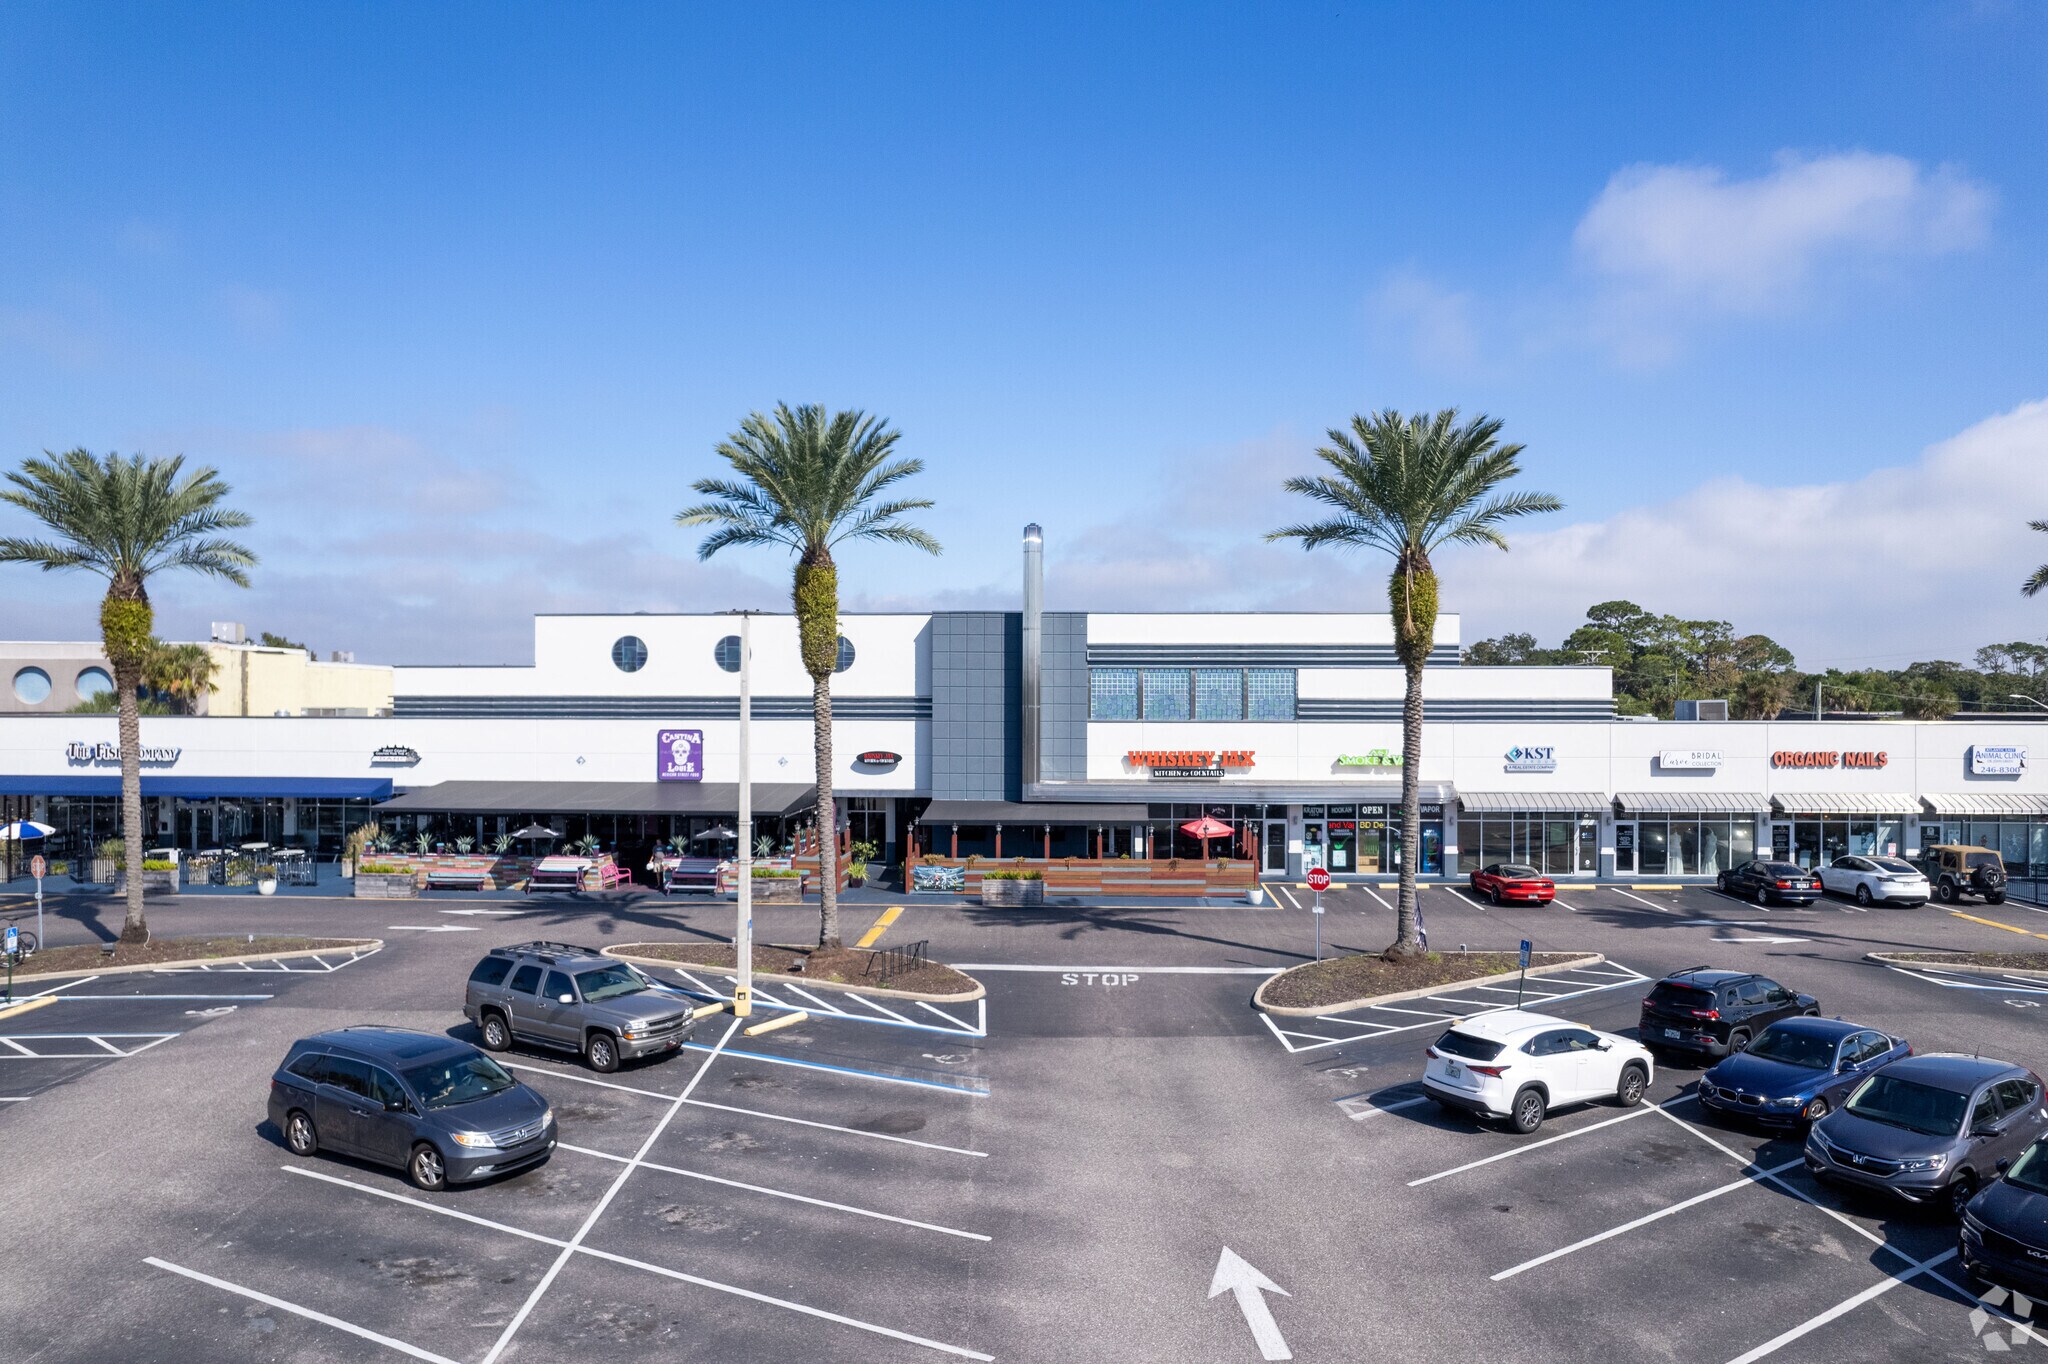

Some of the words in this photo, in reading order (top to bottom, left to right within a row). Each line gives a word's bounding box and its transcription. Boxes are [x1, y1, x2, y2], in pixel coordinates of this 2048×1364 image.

[661, 732, 701, 744] CANTINA
[69, 743, 89, 758] THE
[139, 748, 176, 759] OMPANY
[1524, 747, 1554, 760] KST
[1691, 752, 1722, 760] BRIDAL
[1975, 751, 2002, 759] ANIMAL
[2003, 751, 2027, 759] CLINIC
[1128, 751, 1215, 767] WHISKEY
[1220, 751, 1256, 767] JAX
[1340, 755, 1379, 766] SMOKE
[1381, 756, 1393, 766] &
[1773, 751, 1840, 767] ORGANIC
[1844, 751, 1889, 767] NAILS
[667, 762, 695, 772] LOUIE
[1190, 769, 1224, 777] COCKTAILS
[1362, 806, 1384, 814] OPEN
[1420, 805, 1441, 813] VAPOR
[1308, 874, 1329, 884] STOP
[1061, 973, 1140, 987] STOP
